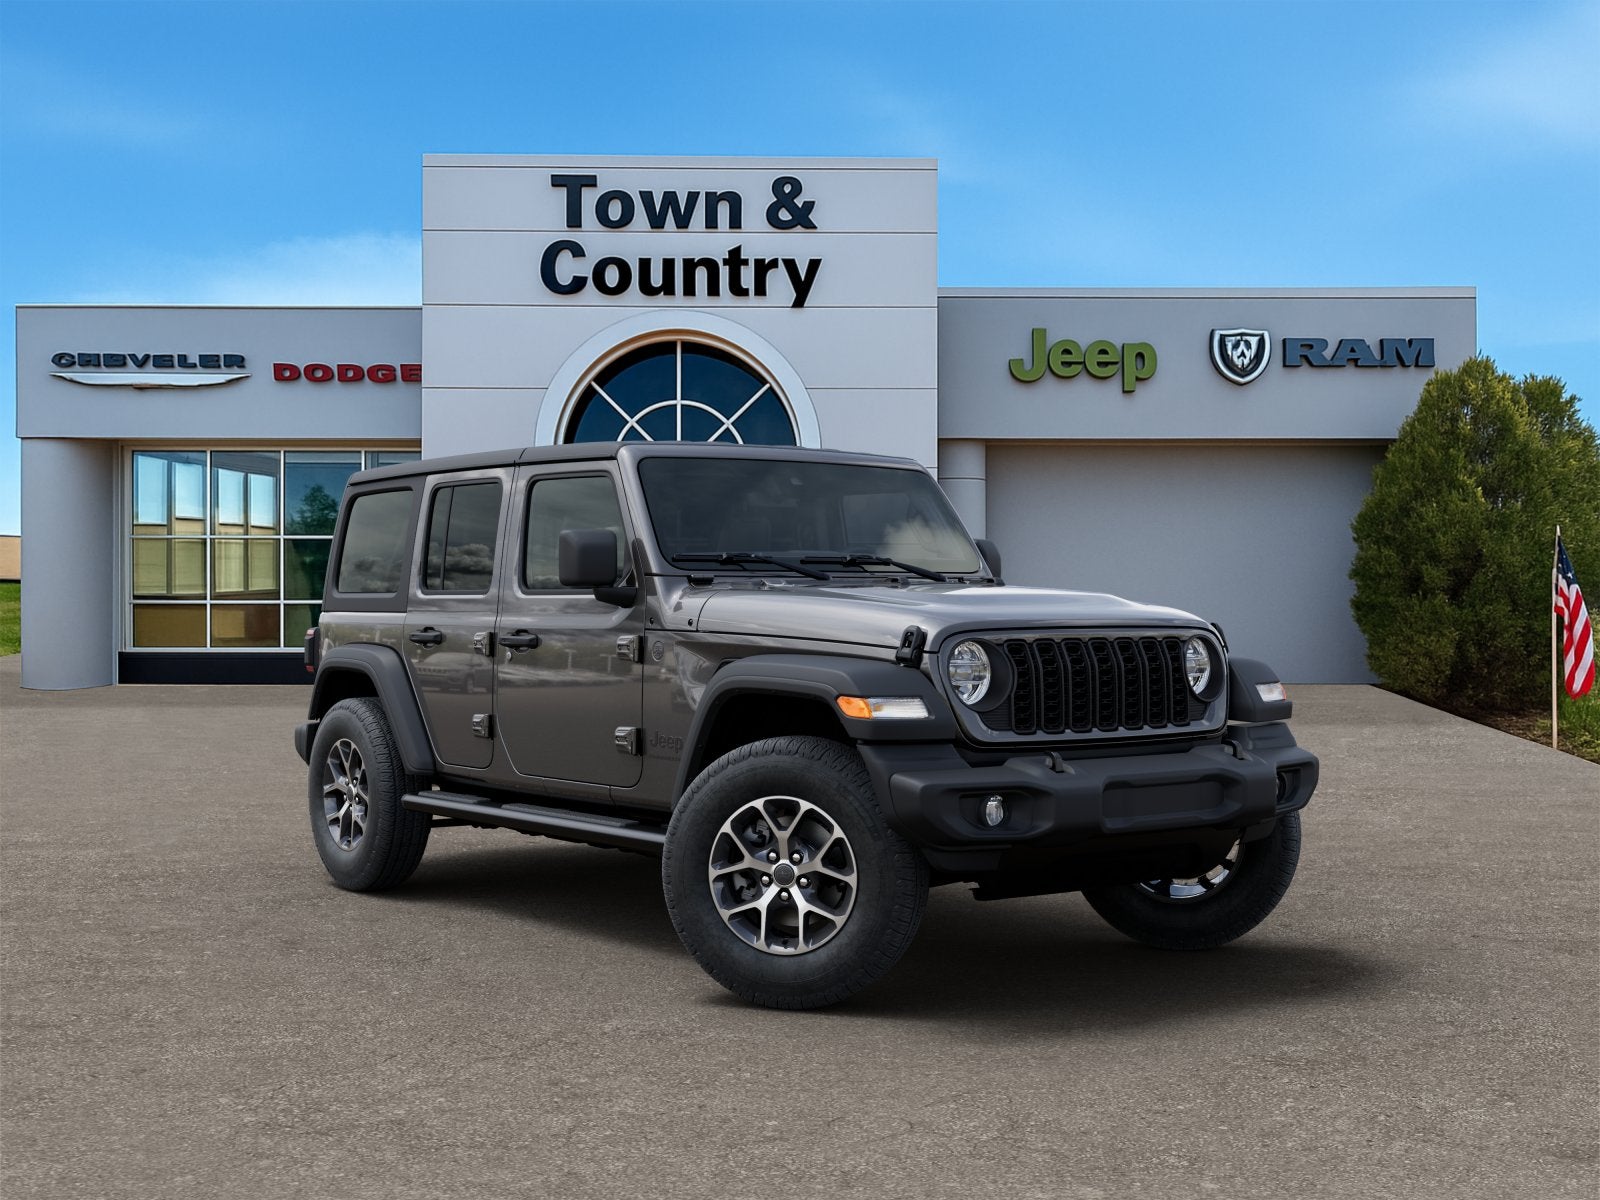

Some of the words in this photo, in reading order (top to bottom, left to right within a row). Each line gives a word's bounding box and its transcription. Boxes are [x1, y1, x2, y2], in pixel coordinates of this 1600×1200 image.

[550, 174, 743, 229] Town
[765, 176, 818, 230] &
[540, 239, 823, 308] Country
[272, 363, 422, 383] DODGE
[1009, 328, 1157, 393] Jeep
[1282, 337, 1436, 368] RAM
[649, 730, 684, 754] Jeep
